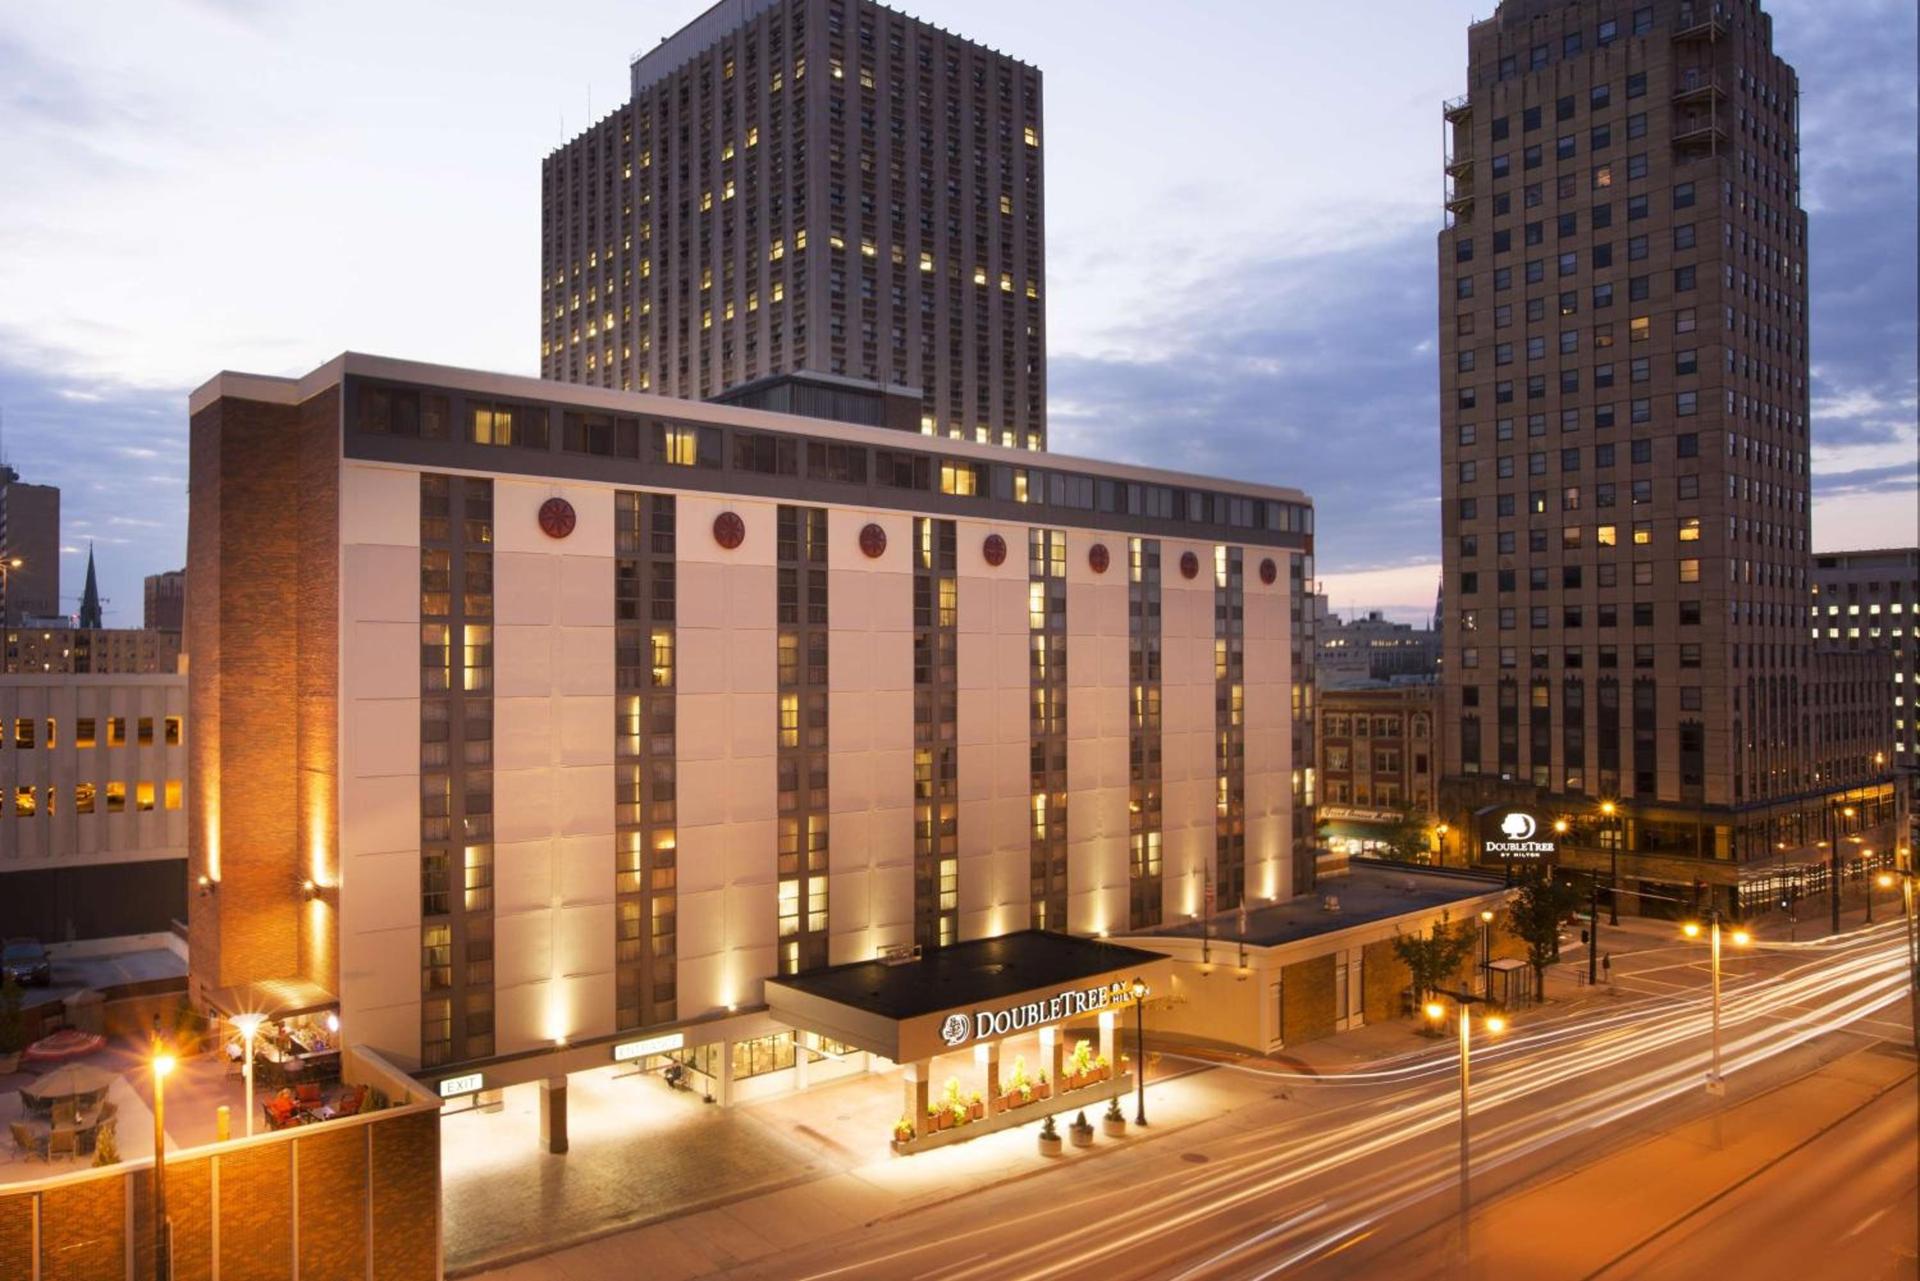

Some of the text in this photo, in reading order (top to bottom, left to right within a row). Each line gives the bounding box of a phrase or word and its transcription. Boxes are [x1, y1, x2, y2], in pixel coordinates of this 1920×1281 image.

[1486, 841, 1554, 852] DOUBLETREE
[1112, 980, 1127, 992] BY
[1112, 985, 1151, 1003] HILTN
[975, 985, 1109, 1040] DOUBLETREE
[447, 1077, 476, 1093] EXIT
